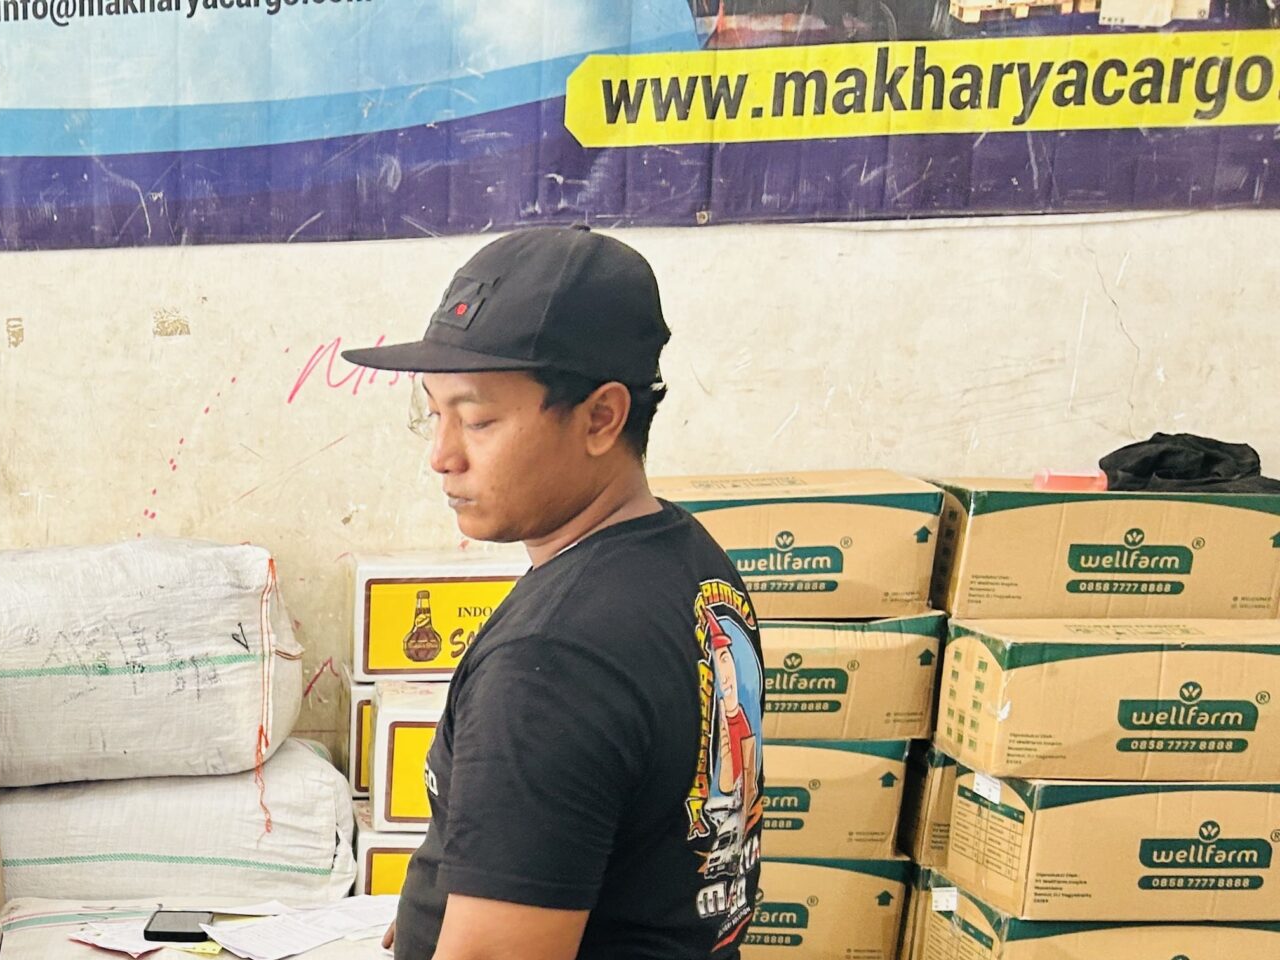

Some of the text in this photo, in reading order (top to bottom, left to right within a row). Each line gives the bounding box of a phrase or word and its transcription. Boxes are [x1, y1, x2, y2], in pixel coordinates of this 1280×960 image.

[736, 552, 832, 572] wellfarm
[1079, 550, 1180, 570] wellfarm
[770, 581, 795, 591] 7777
[1079, 582, 1171, 593] 0858 7777 8888
[765, 673, 836, 690] ellfarm
[1131, 705, 1244, 726] wellfarm
[1130, 740, 1233, 751] 0858 7777 8888
[1151, 842, 1259, 864] wellfarm
[1151, 877, 1250, 888] 0858 7777 8888
[753, 907, 797, 924] farm
[745, 935, 761, 943] 777
